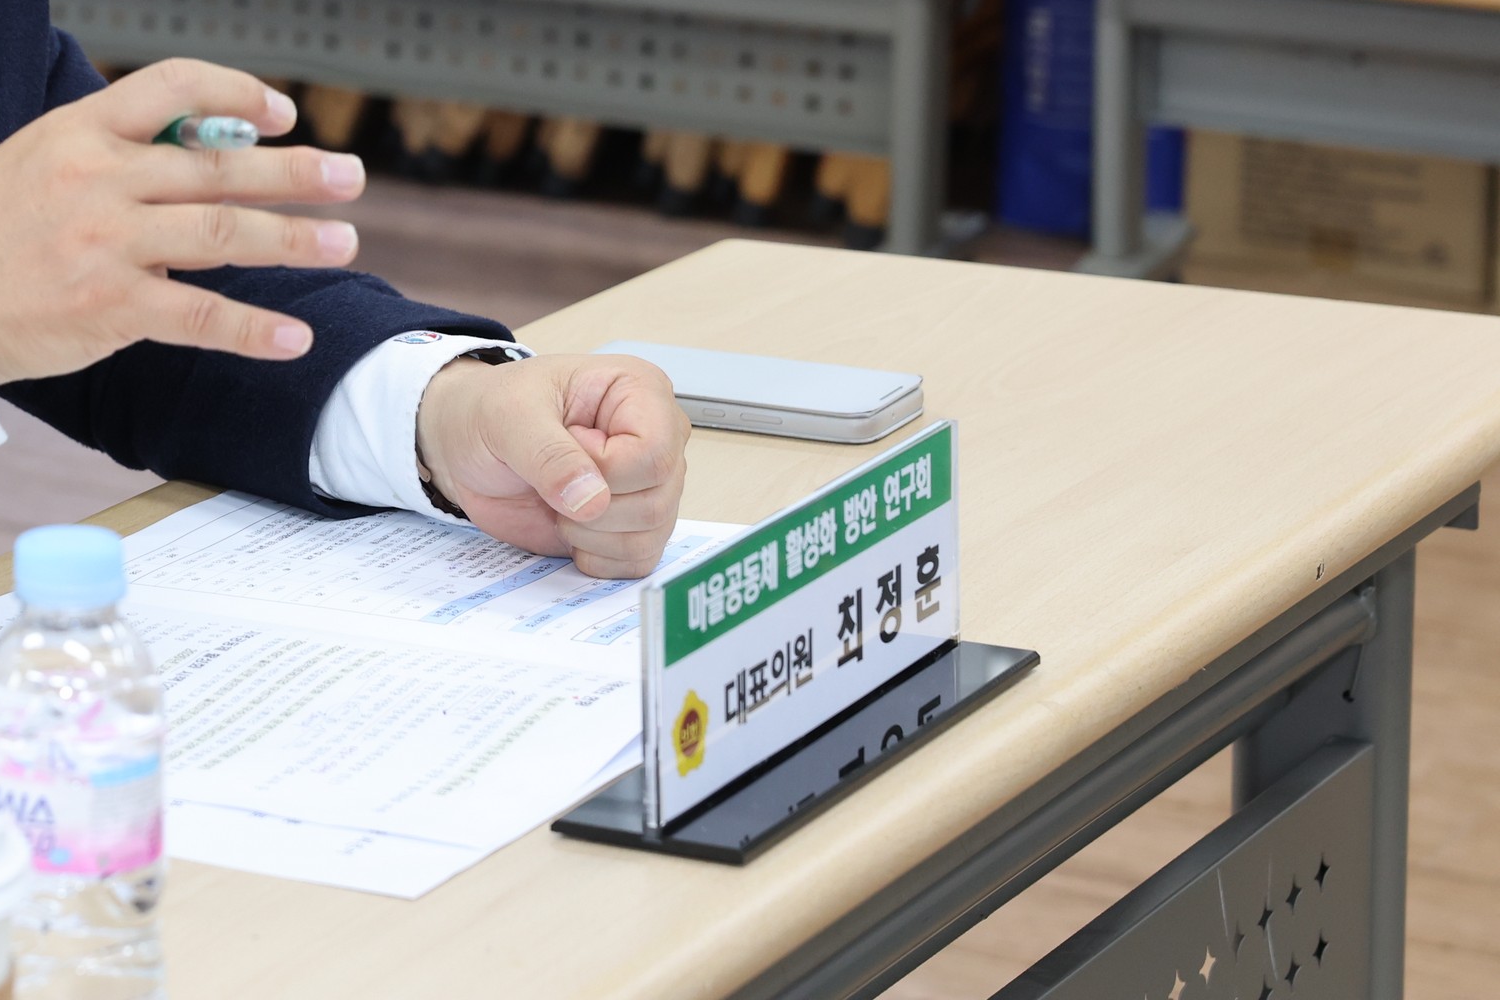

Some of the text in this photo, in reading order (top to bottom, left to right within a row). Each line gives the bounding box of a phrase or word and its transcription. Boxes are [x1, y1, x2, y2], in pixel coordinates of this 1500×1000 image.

[687, 539, 780, 633] 마을공동체
[784, 507, 838, 580] 활성화
[843, 484, 878, 545] 방안
[883, 452, 932, 522] 연구회
[724, 544, 941, 725] 대표의원 최정훈
